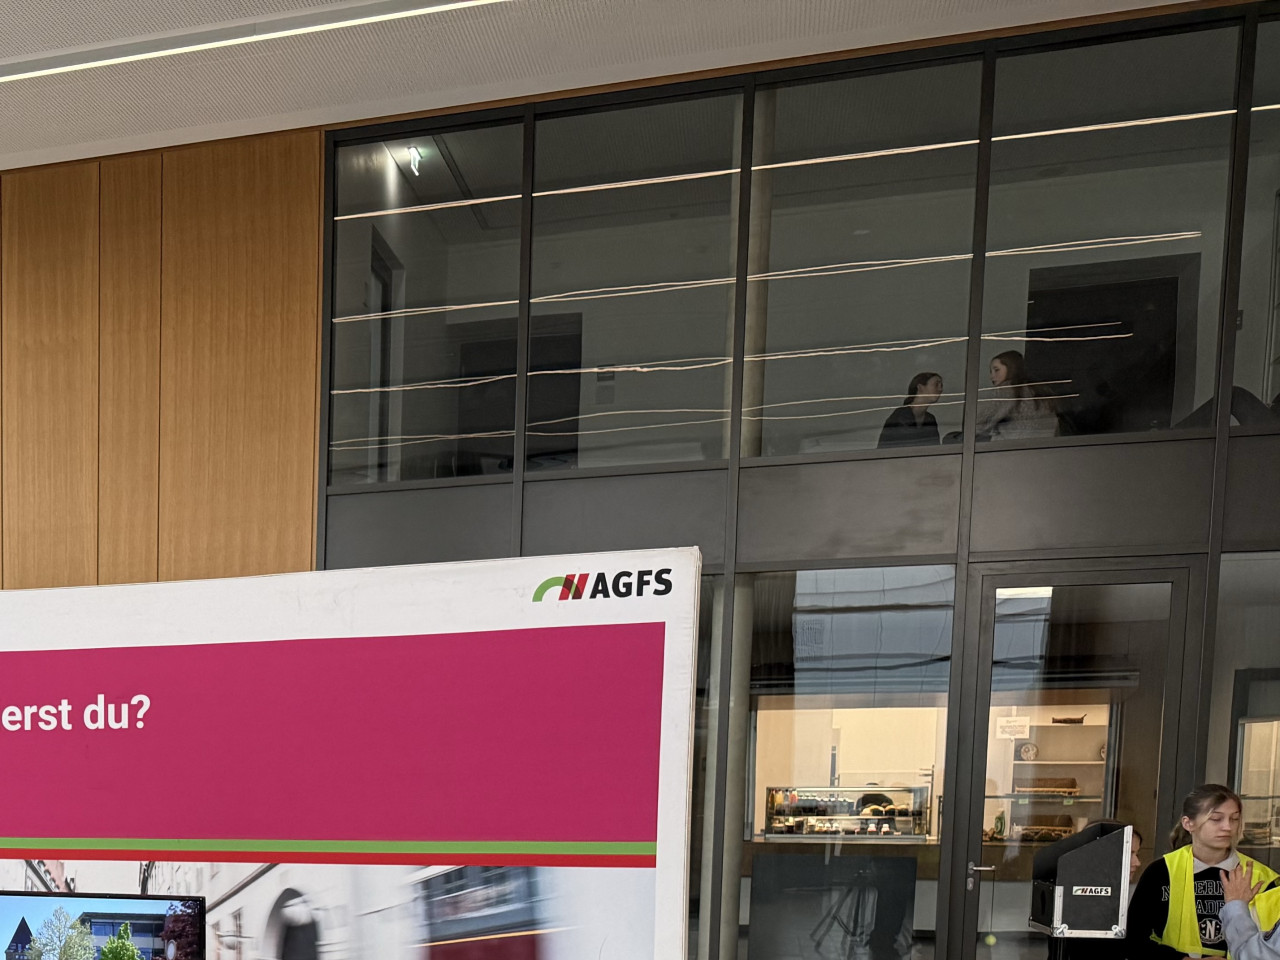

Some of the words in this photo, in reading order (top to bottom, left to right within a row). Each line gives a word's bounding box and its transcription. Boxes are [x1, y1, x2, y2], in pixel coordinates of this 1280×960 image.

[589, 567, 673, 600] AGFS
[83, 693, 152, 730] du?
[1088, 887, 1110, 895] AGFS
